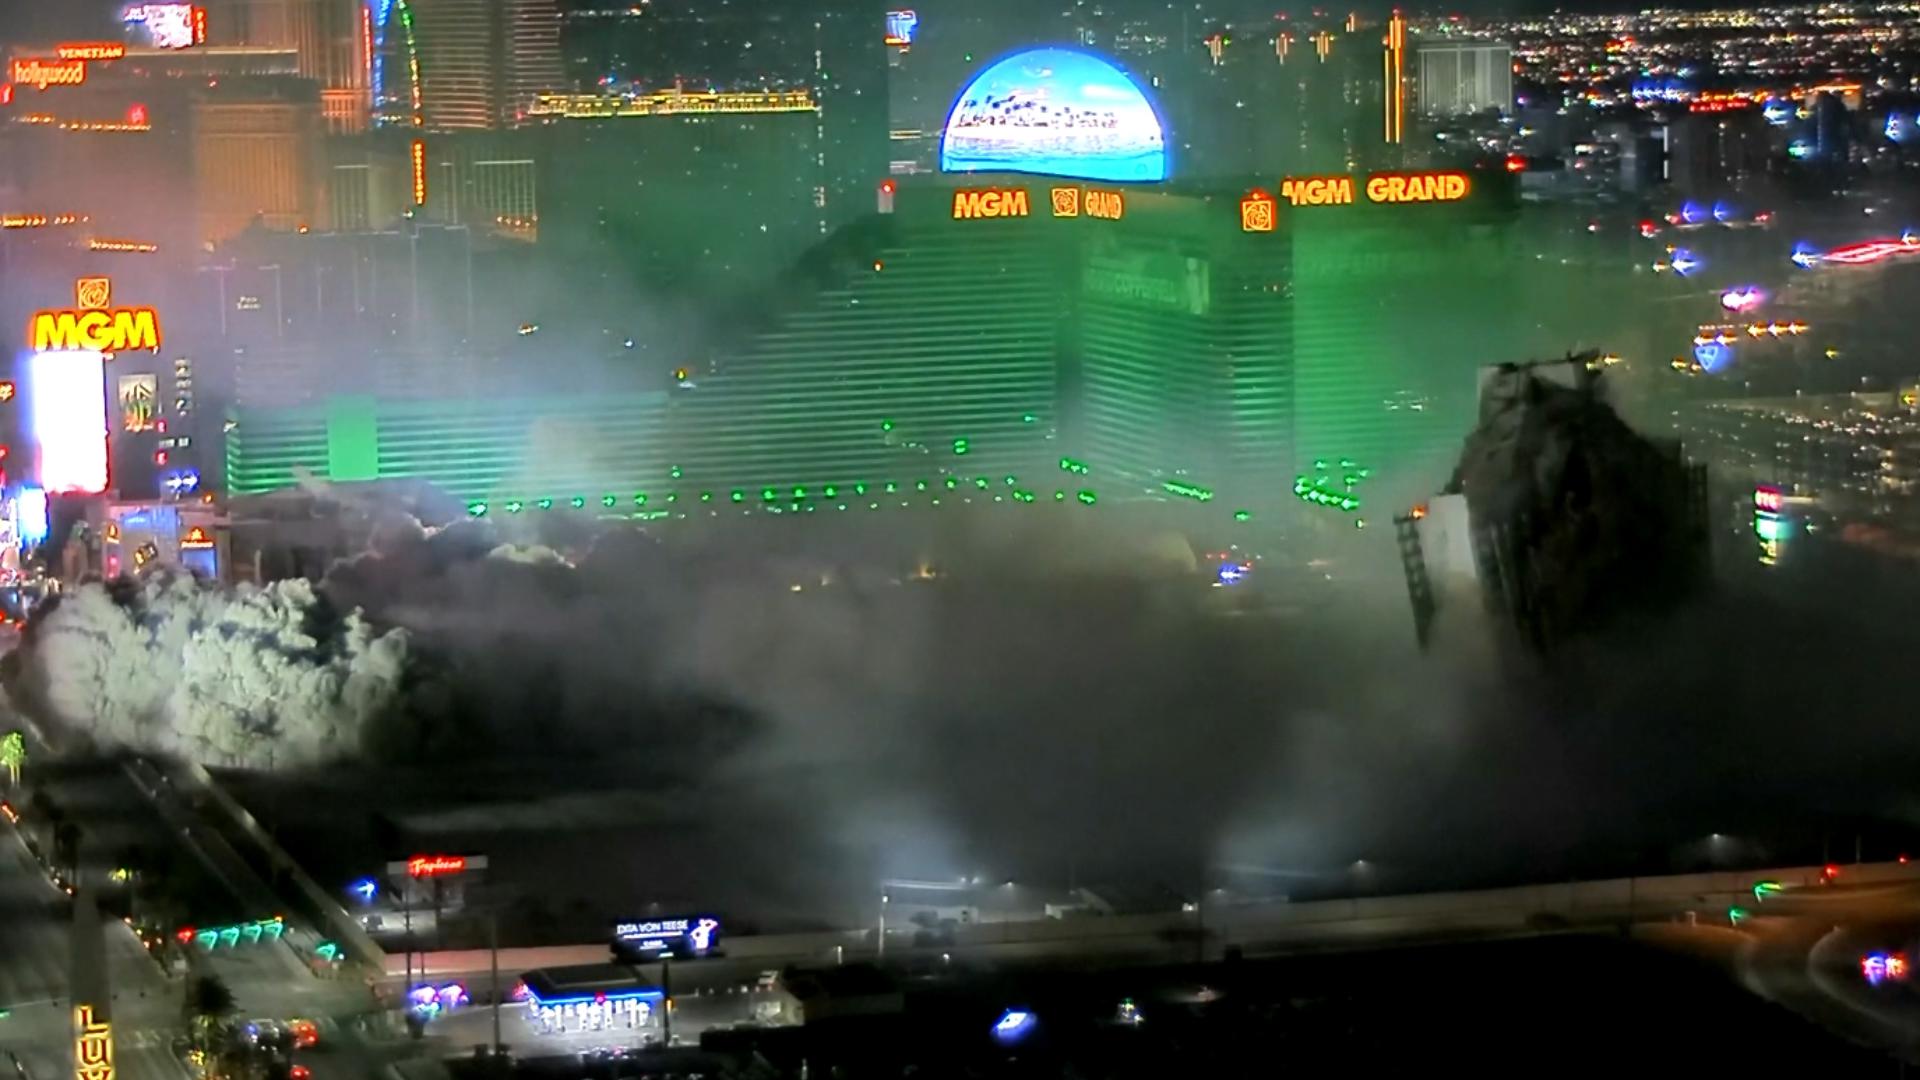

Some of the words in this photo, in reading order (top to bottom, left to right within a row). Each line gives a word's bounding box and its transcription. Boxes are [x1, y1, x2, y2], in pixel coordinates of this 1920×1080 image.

[58, 47, 124, 58] VENETIAN
[14, 61, 84, 89] hollywood
[1366, 175, 1466, 201] GRAND
[953, 191, 1028, 218] MGM
[1085, 192, 1122, 219] GRAND
[35, 310, 158, 351] MGM
[639, 922, 661, 932] VON
